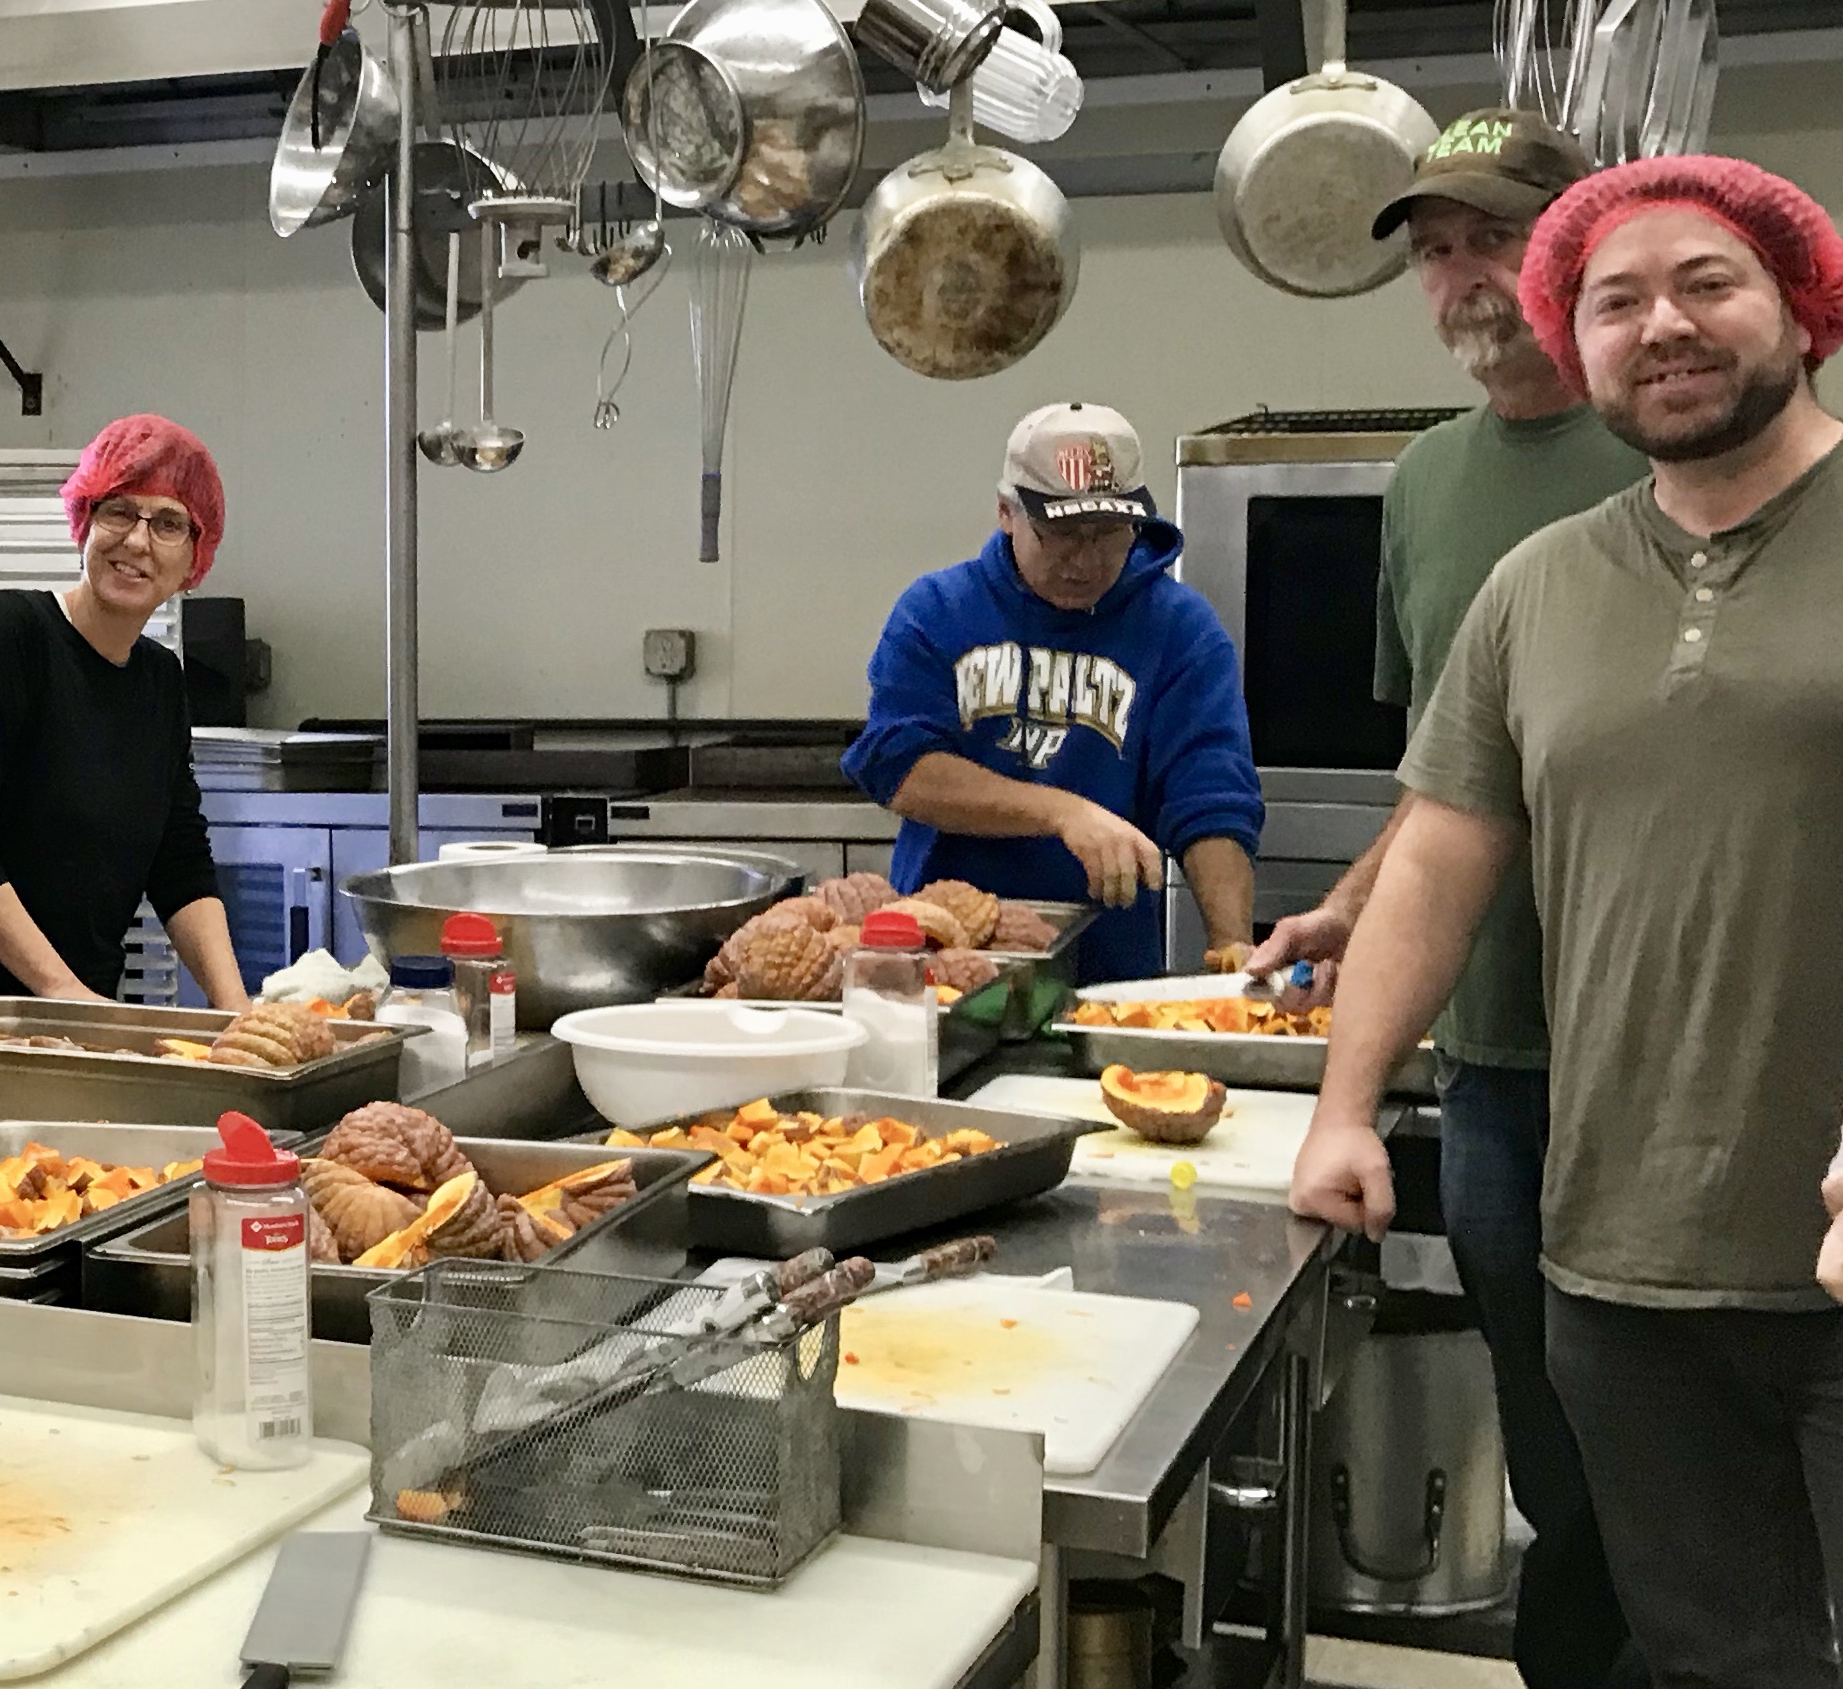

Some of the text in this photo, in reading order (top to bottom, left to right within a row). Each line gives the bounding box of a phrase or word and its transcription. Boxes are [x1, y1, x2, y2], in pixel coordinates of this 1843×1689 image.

[1425, 136, 1503, 163] TEAM
[1437, 119, 1513, 142] LEAN
[953, 640, 1137, 751] NEW PALTZ
[996, 716, 1070, 770] NP
